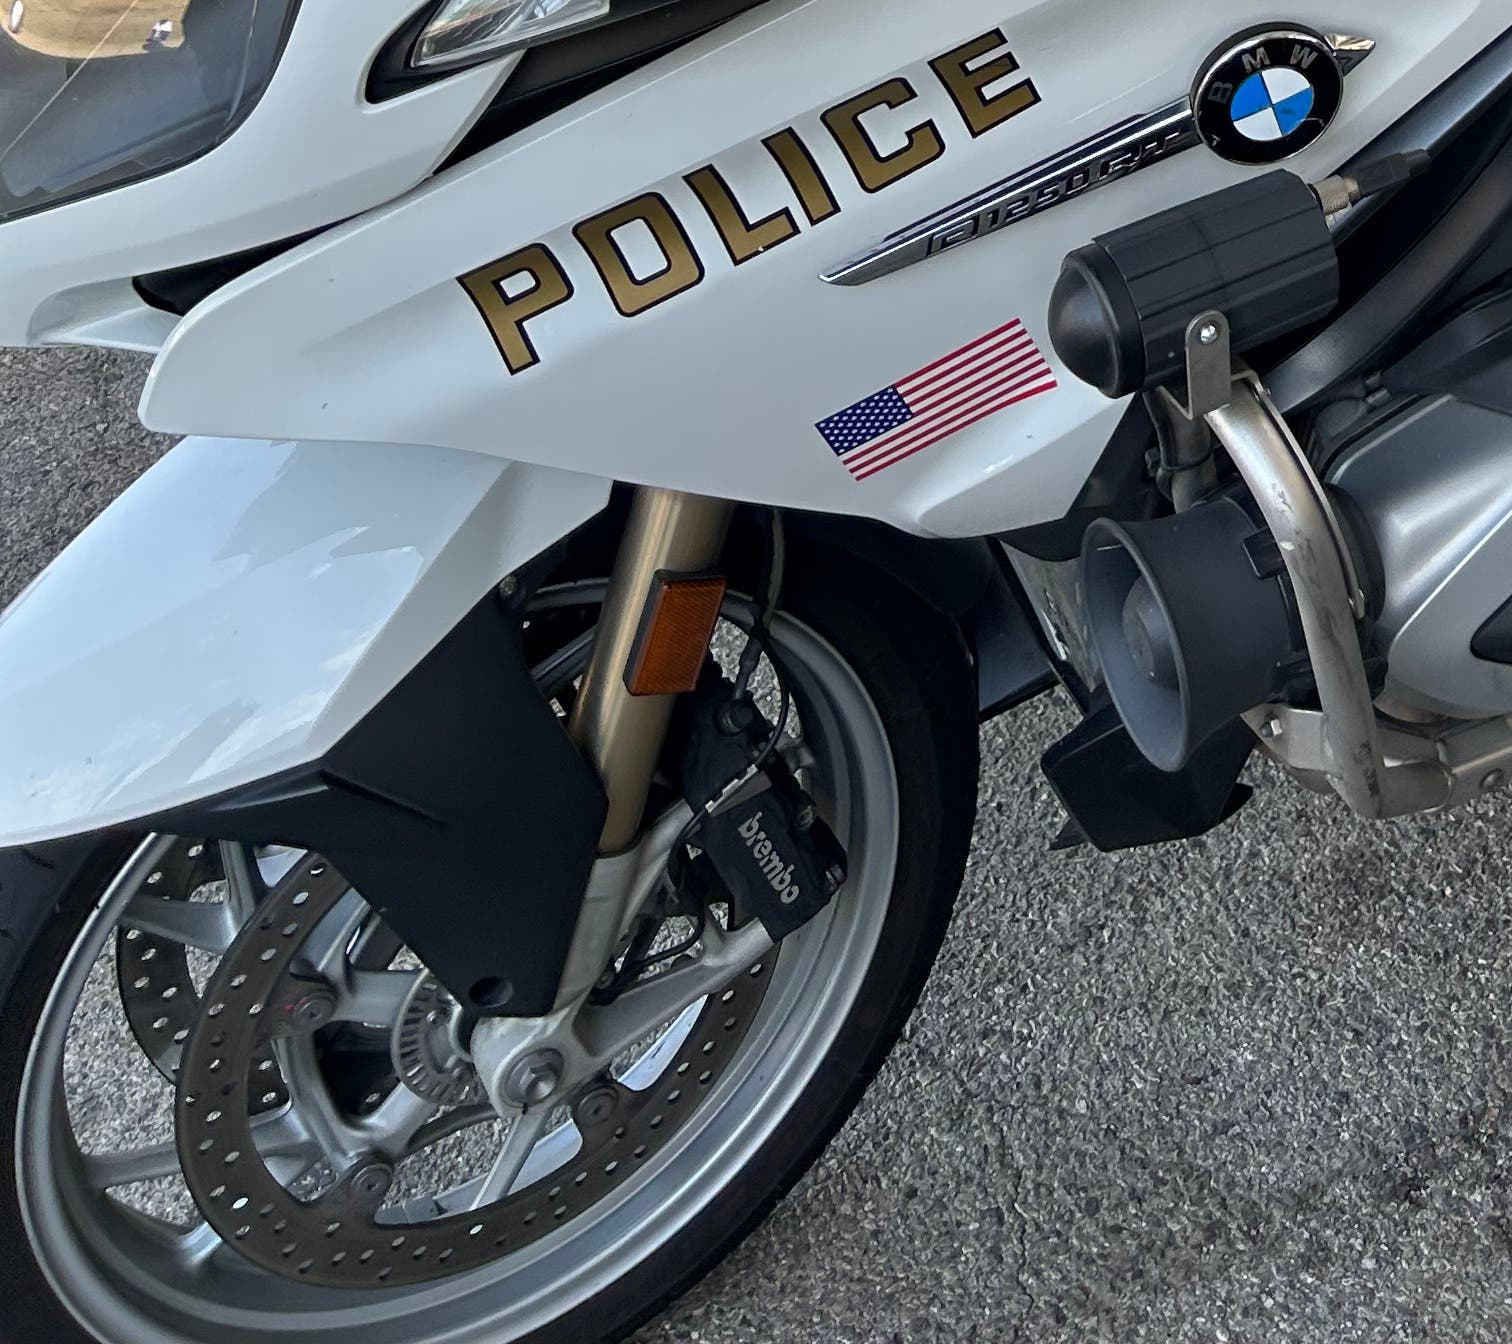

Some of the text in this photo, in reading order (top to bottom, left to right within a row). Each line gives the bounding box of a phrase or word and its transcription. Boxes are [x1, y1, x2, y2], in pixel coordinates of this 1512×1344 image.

[1207, 43, 1319, 106] BMW
[455, 27, 1042, 376] POLICE
[737, 810, 800, 905] brembo
